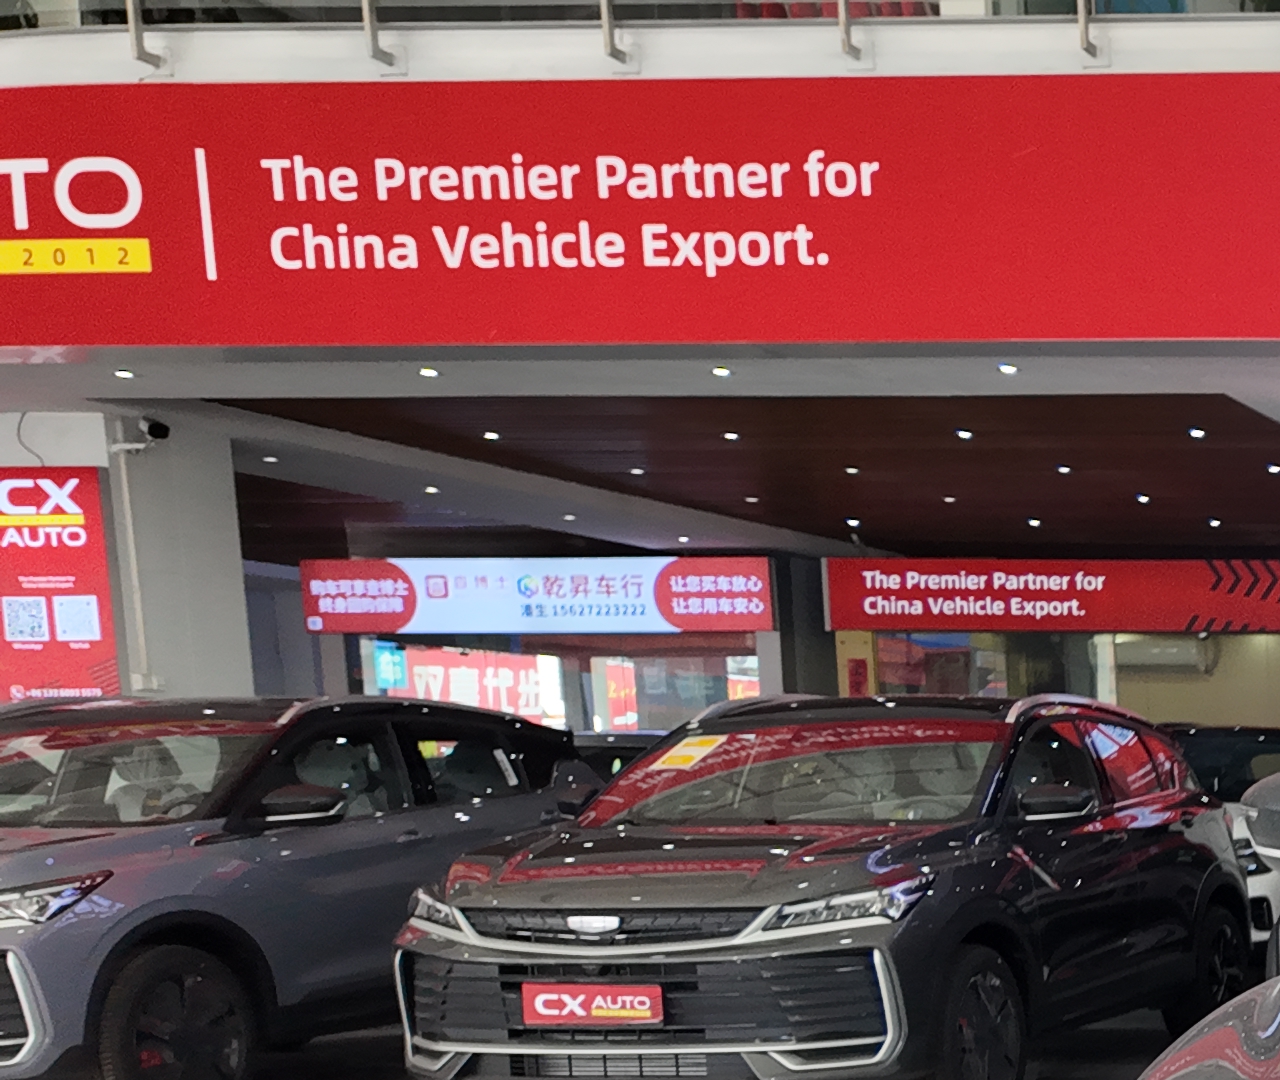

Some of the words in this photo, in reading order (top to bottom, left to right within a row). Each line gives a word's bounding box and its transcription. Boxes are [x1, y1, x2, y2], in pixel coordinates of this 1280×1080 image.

[260, 155, 358, 201] The
[374, 153, 580, 201] Premier
[596, 155, 790, 199] Partner
[804, 150, 880, 197] for
[22, 247, 130, 267] 2012
[270, 223, 418, 270] China
[432, 220, 626, 269] Vehicle
[641, 223, 829, 277] Export.
[0, 478, 83, 514] CX
[1, 527, 87, 547] AUTO
[863, 570, 901, 589] The
[906, 571, 988, 590] Premier
[993, 572, 1070, 590] Partner
[1075, 571, 1105, 590] for
[863, 596, 923, 615] China
[928, 596, 1005, 615] Vehicle
[1010, 598, 1086, 619] Export.
[534, 994, 587, 1016] CX
[592, 995, 650, 1010] AUTO
